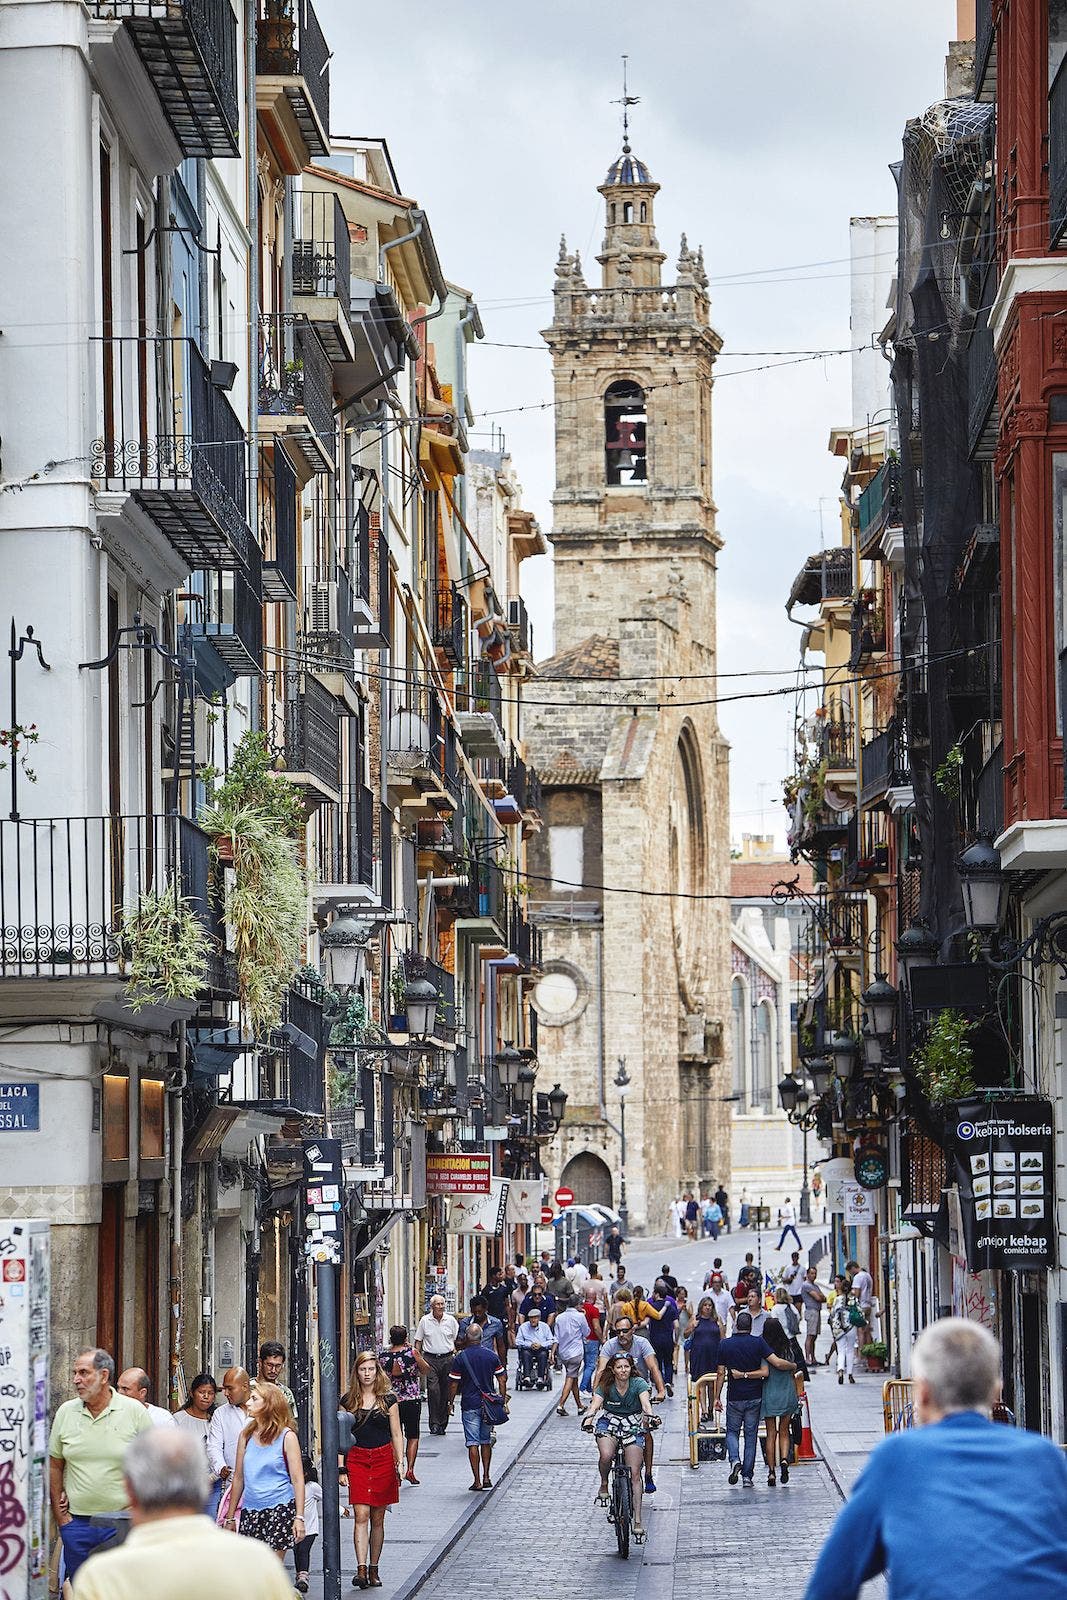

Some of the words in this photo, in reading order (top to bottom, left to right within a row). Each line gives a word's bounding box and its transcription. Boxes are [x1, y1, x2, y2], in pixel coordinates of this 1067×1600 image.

[0, 1087, 28, 1097] LACA
[0, 1114, 27, 1128] SSAL
[975, 1125, 1006, 1138] kebap
[1008, 1124, 1051, 1136] bolsería
[496, 1185, 508, 1235] RESTAURANT
[983, 1235, 1007, 1248] mejor
[1010, 1235, 1047, 1248] kebap
